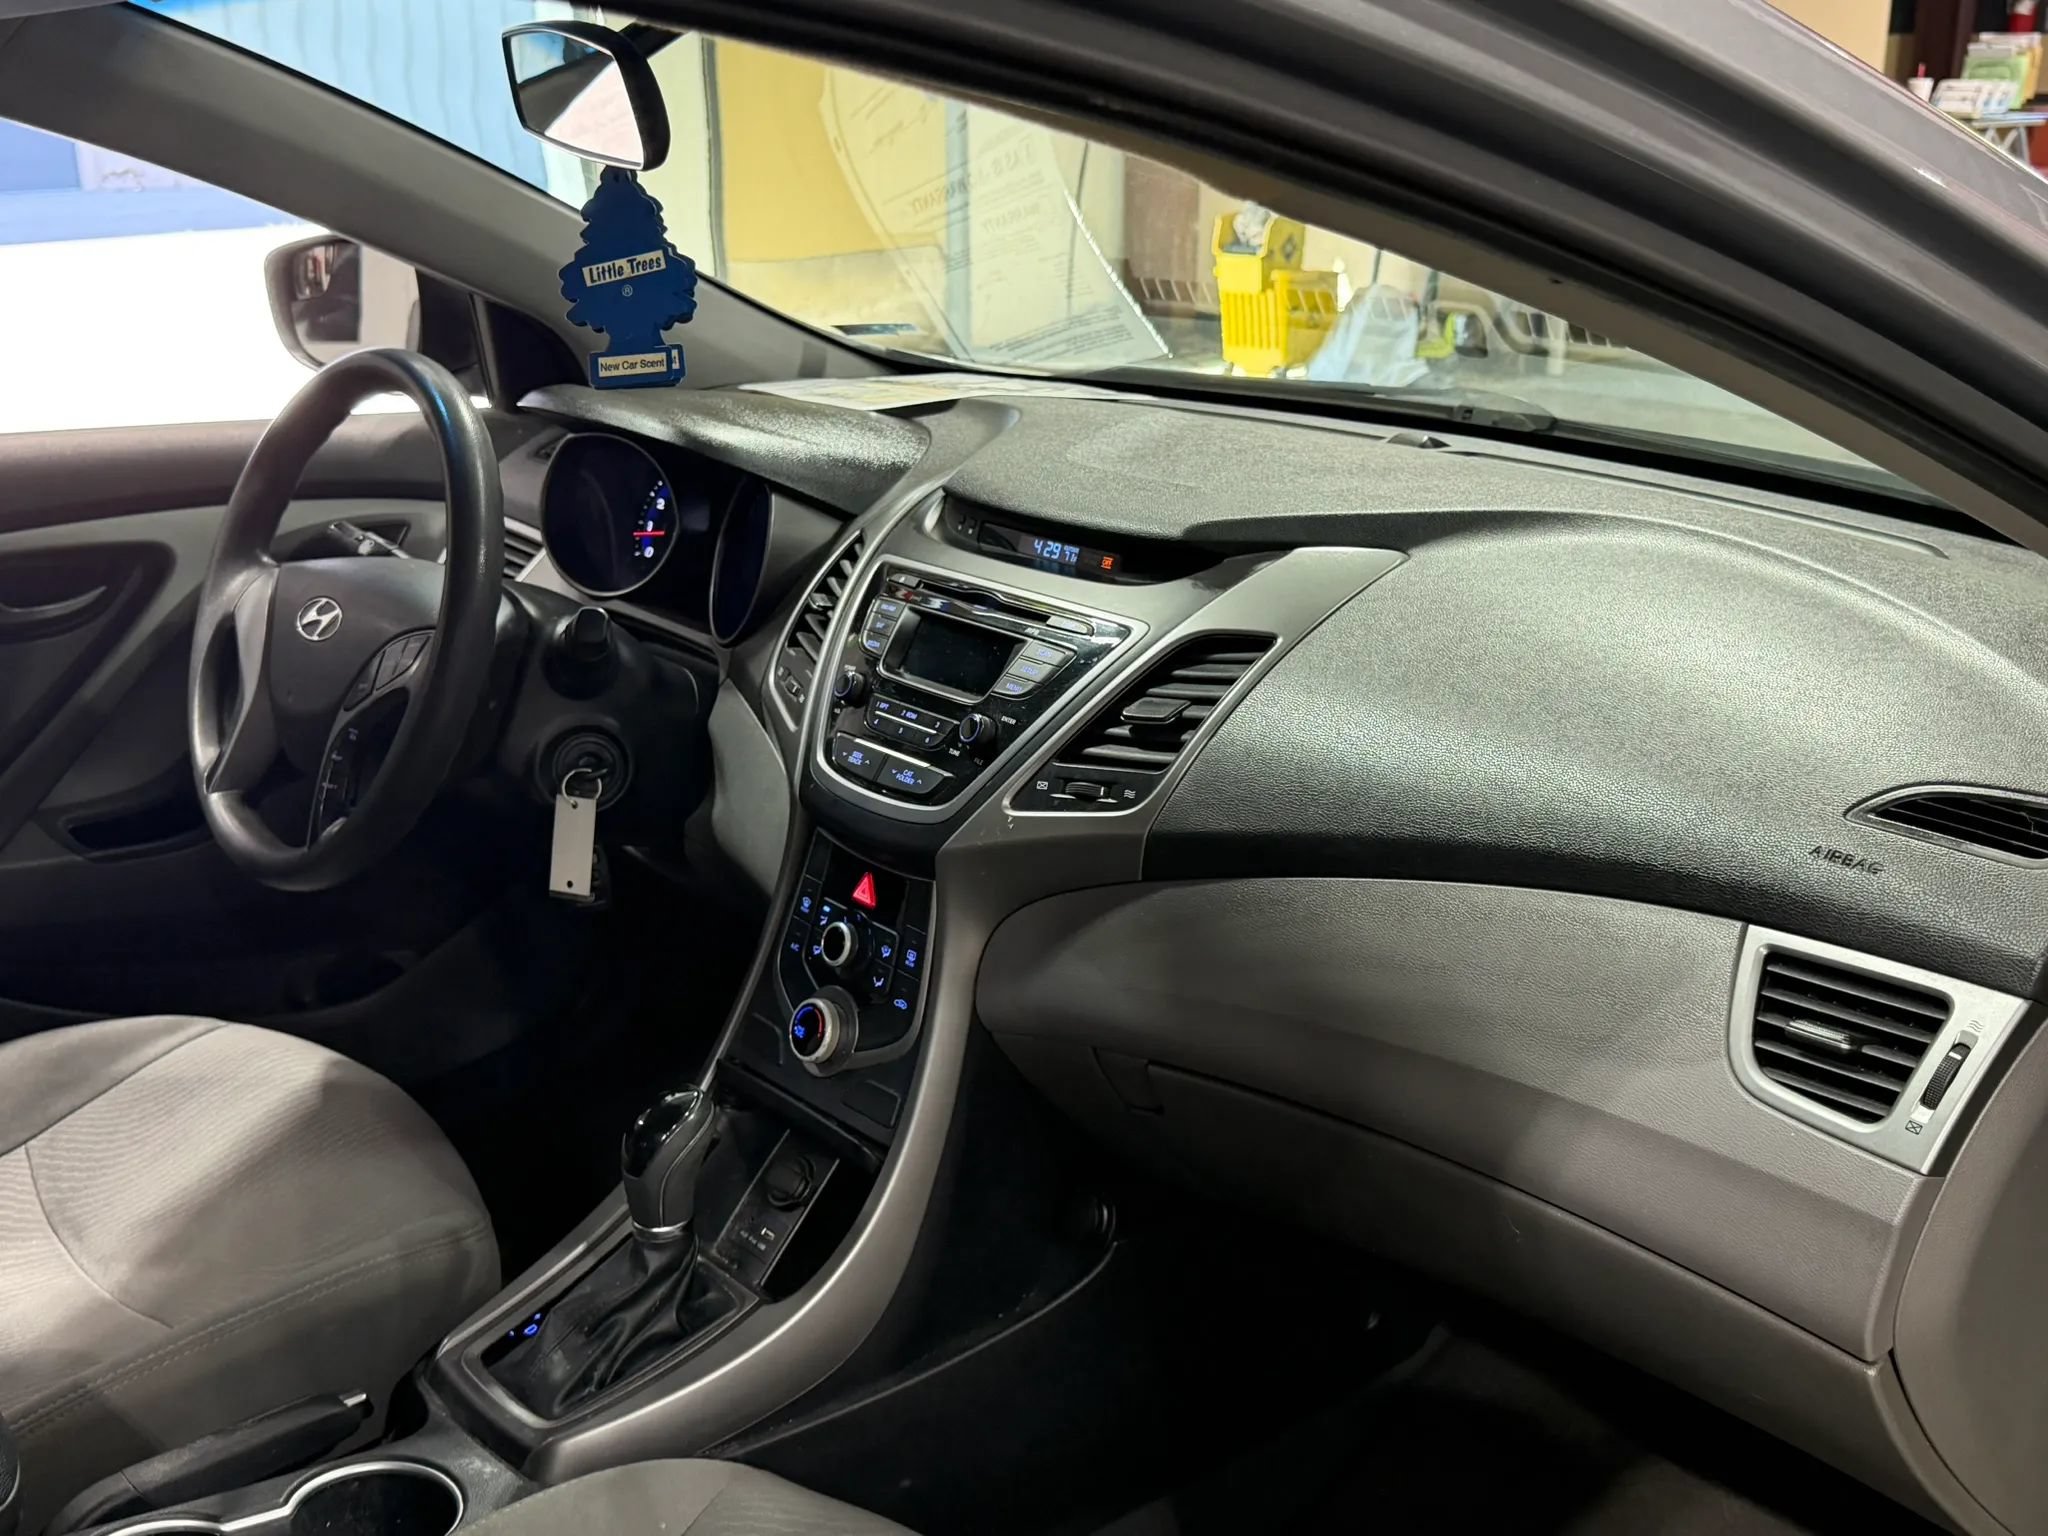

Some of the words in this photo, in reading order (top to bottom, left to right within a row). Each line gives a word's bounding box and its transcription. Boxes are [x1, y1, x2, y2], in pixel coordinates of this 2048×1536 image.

[589, 263, 624, 283] Little
[627, 256, 661, 274] Trees
[600, 363, 619, 372] New
[622, 361, 638, 370] Car
[640, 358, 664, 369] Scent
